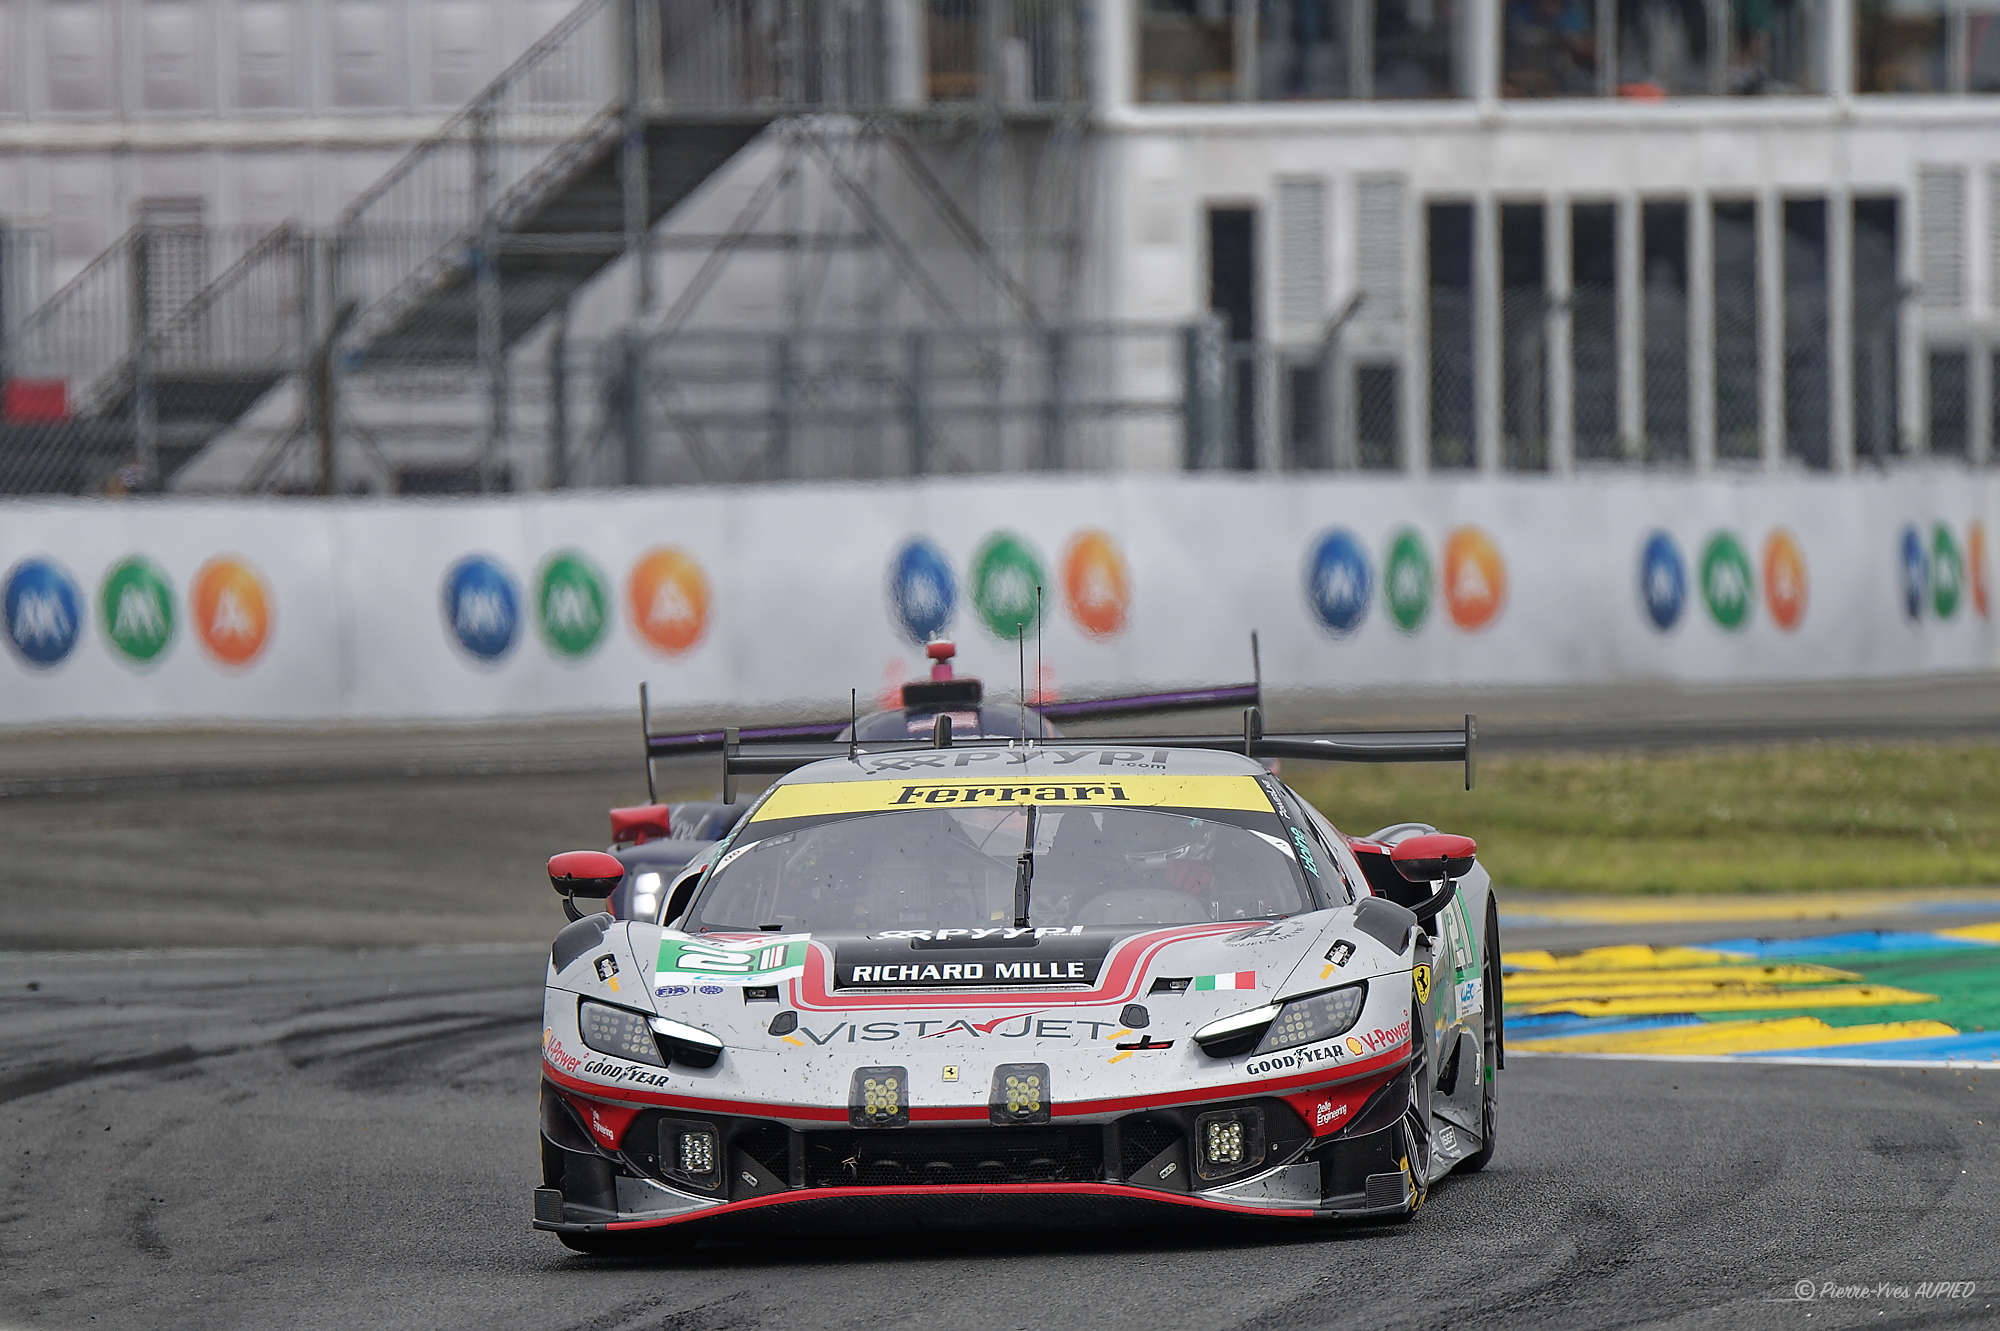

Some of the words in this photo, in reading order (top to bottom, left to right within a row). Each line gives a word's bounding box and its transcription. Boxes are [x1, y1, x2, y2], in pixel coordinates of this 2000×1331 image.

[888, 782, 1130, 805] Ferrari
[852, 963, 984, 982] RICHARD
[995, 961, 1085, 979] MILLE
[1360, 1020, 1410, 1051] V-Power
[546, 1034, 582, 1073] V-Power
[1316, 1103, 1348, 1126] Engineering
